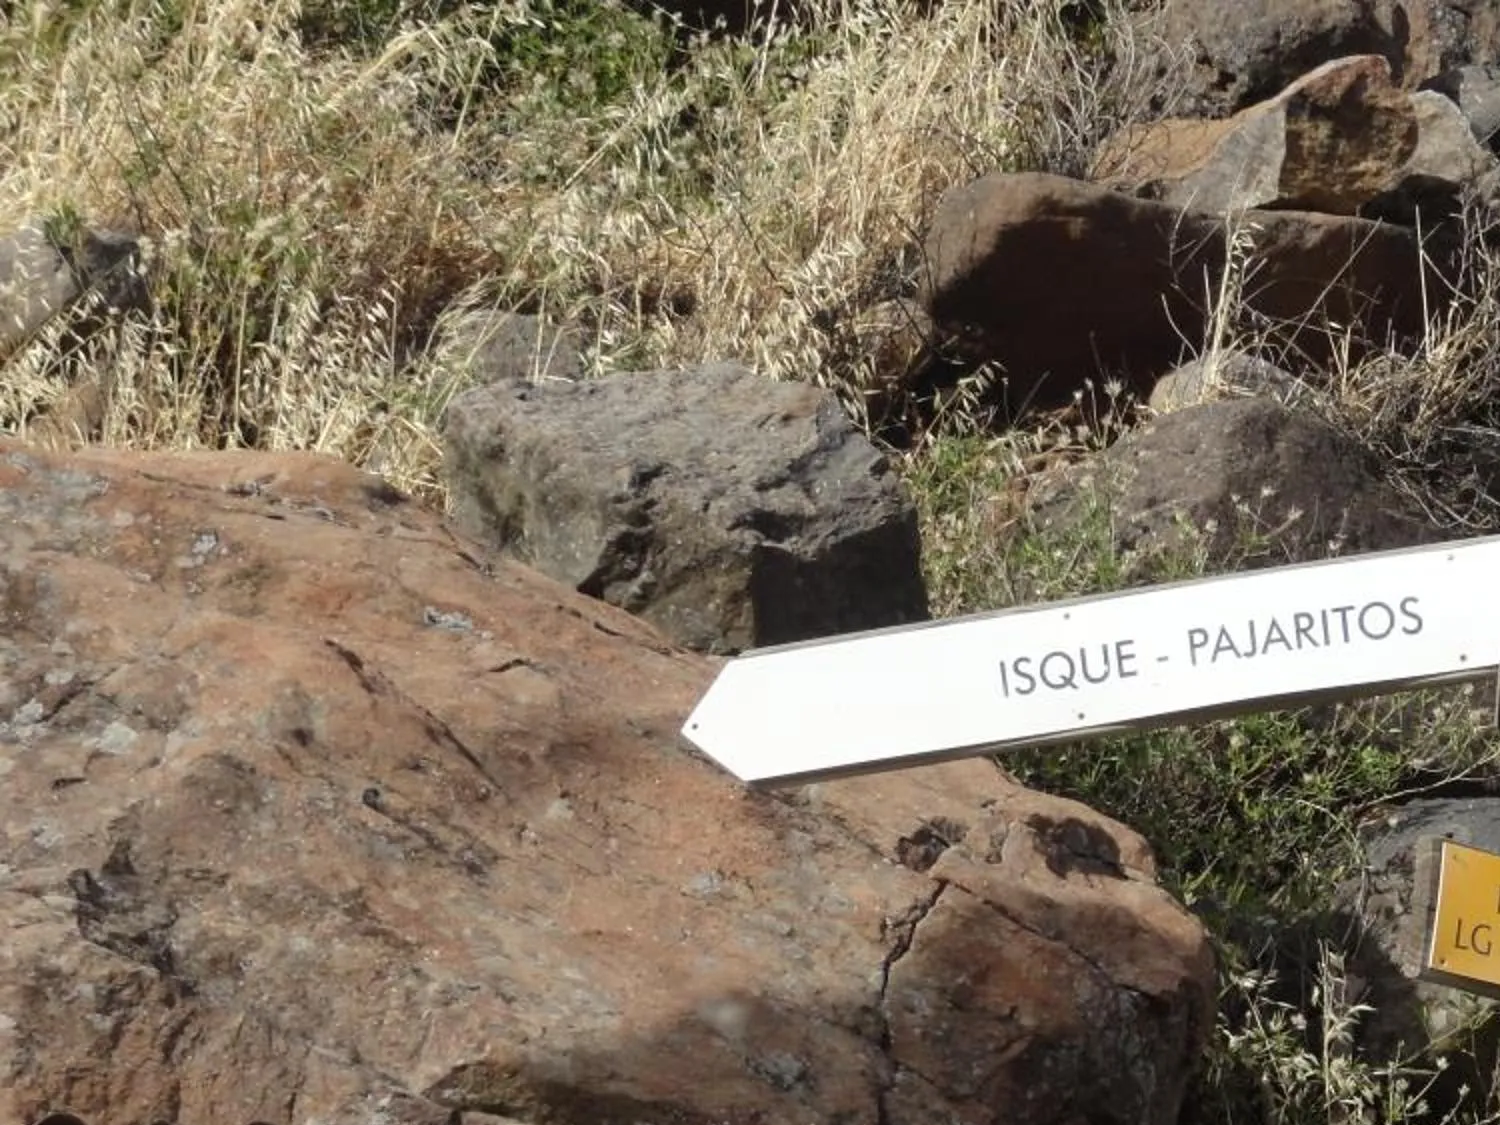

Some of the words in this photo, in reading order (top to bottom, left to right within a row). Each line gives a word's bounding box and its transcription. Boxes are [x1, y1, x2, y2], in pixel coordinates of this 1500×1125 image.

[999, 640, 1138, 698] ISQUE
[1187, 597, 1425, 666] PAJARITOS
[1454, 918, 1492, 956] LG
